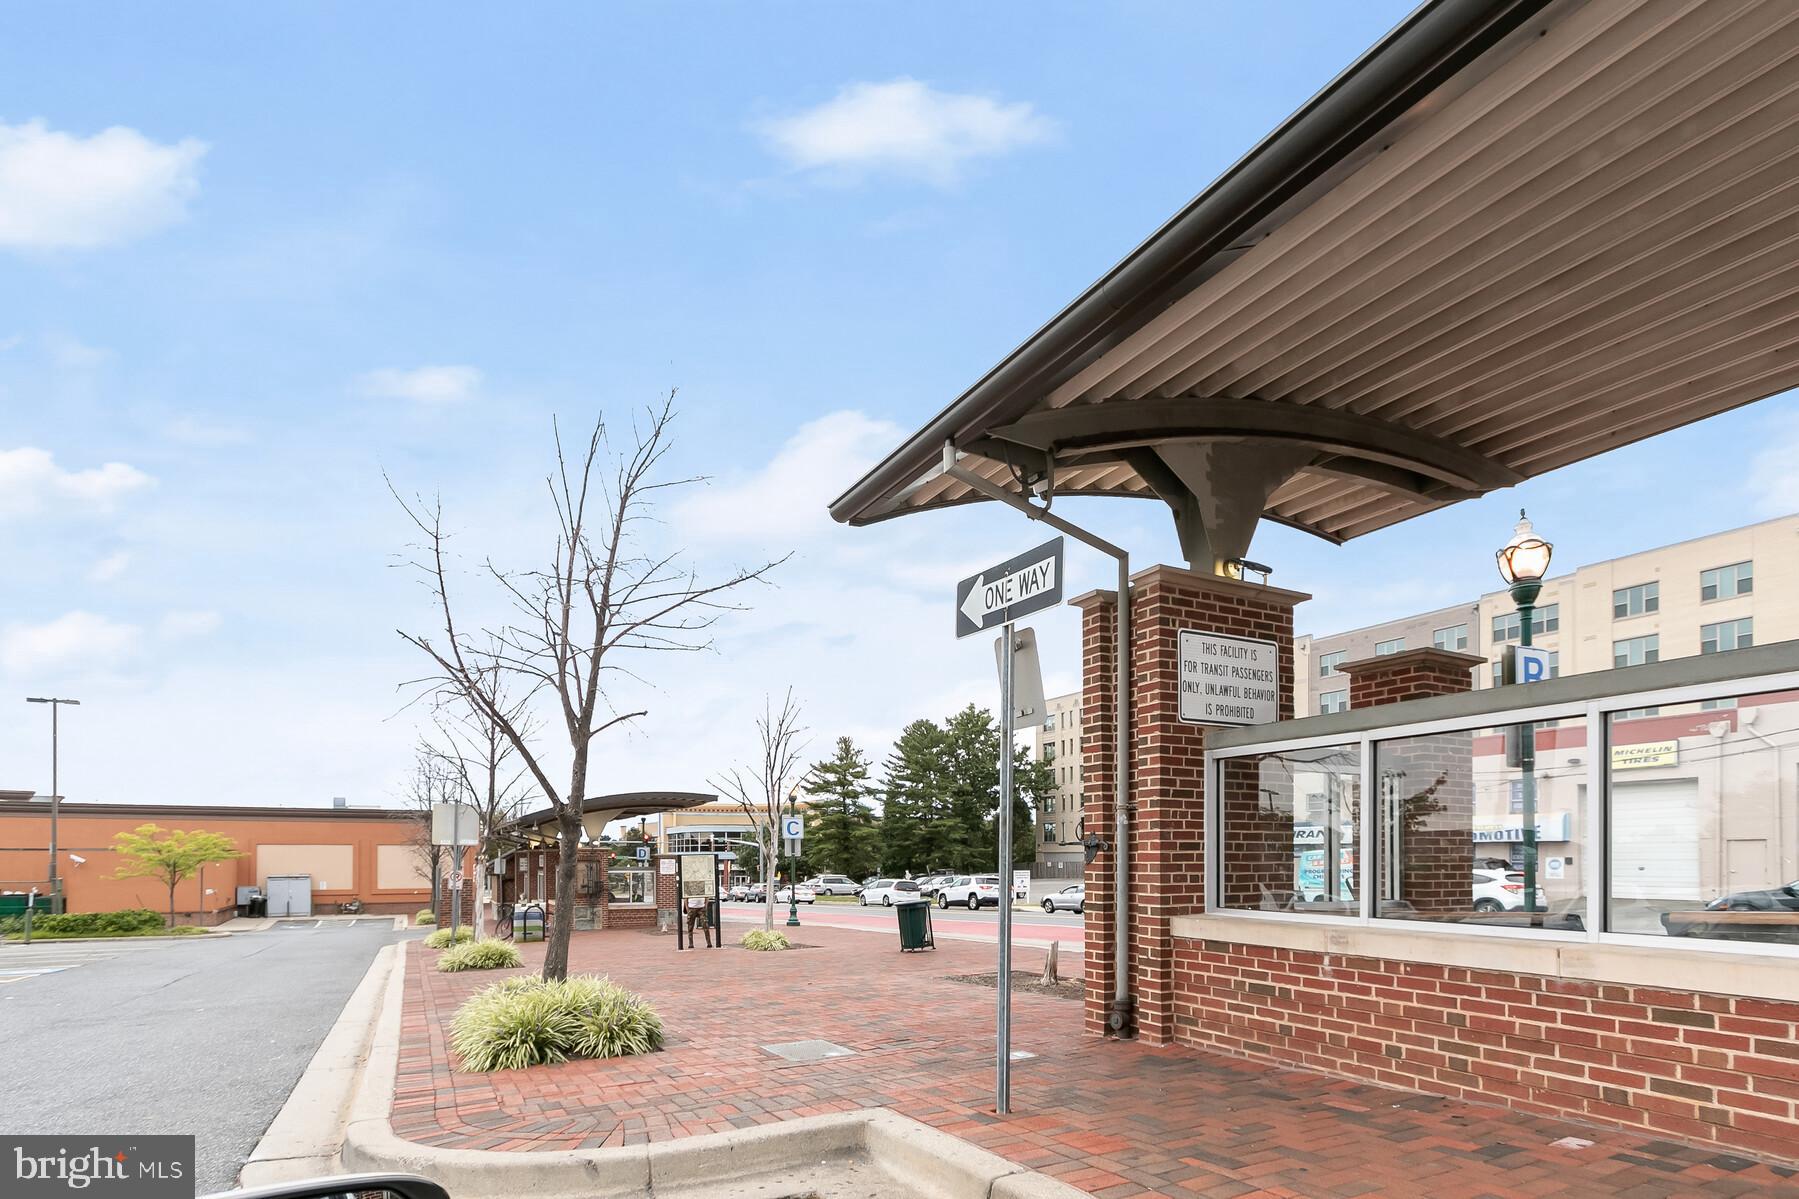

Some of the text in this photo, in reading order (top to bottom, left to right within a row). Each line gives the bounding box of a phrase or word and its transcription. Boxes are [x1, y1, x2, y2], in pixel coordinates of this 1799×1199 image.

[985, 562, 1051, 610] ONE WAY
[1202, 642, 1257, 661] THIS FACILITY IS
[1184, 660, 1273, 683] FOR TRANSIT PASSENGERS
[1205, 683, 1241, 699] UNLAWFUL
[1244, 687, 1275, 702] BEHAVIOR
[1206, 703, 1254, 719] IS PROHIBITED
[1614, 746, 1673, 756] MICHELIN
[1622, 756, 1660, 765] TIRES
[786, 821, 800, 836] C
[639, 848, 646, 858] D
